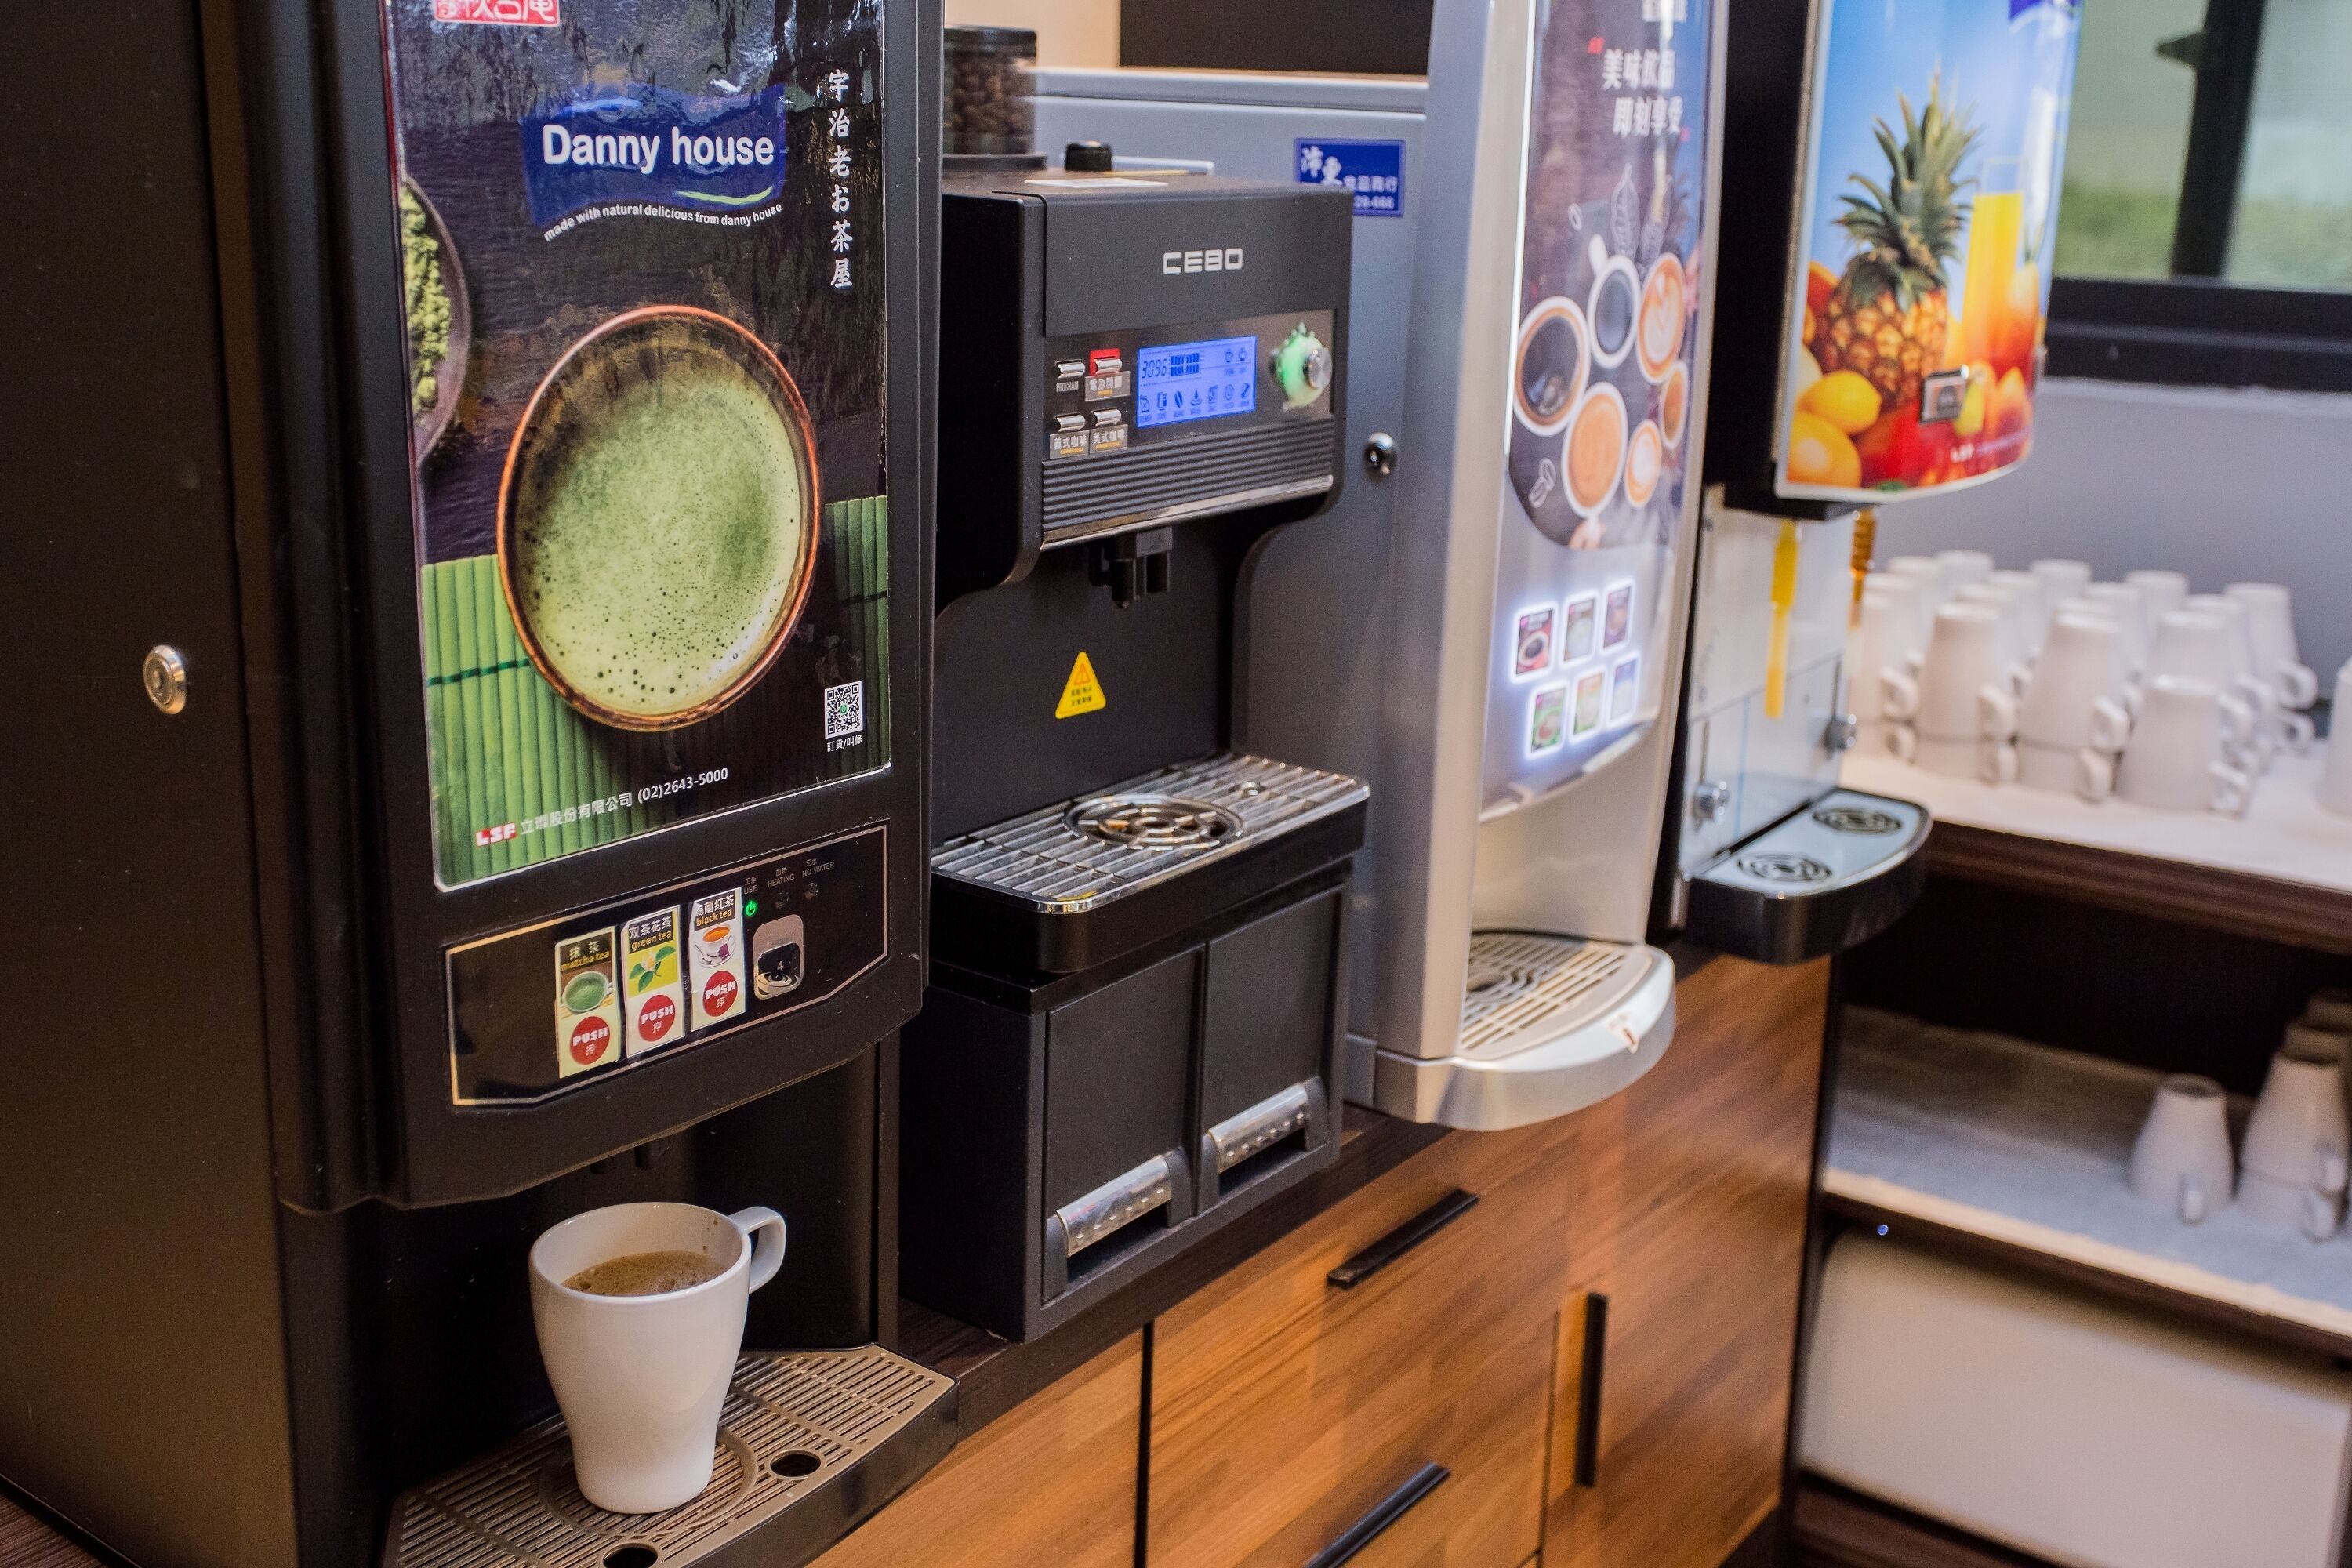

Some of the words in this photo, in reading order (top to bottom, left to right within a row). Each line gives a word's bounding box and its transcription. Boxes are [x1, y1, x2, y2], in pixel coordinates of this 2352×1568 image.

[543, 125, 660, 174] Danny
[672, 126, 774, 165] house
[828, 68, 853, 289] 宇治老お茶屋
[544, 218, 575, 241] made
[575, 207, 601, 224] with
[602, 204, 643, 217] natural
[644, 206, 694, 222] delicious
[695, 212, 720, 226] from
[720, 214, 753, 227] danny
[753, 203, 782, 223] house
[1163, 248, 1243, 274] CEBO
[1142, 359, 1167, 379] 3096
[826, 734, 862, 753] 訂貨/叫修
[476, 822, 516, 847] LSF
[637, 767, 728, 804] (02)2643-5000
[802, 868, 811, 877] NO
[813, 861, 835, 873] WATER
[768, 873, 795, 887] HEATING
[696, 912, 719, 926] black
[719, 909, 732, 919] tea
[629, 916, 672, 940] 双茶花茶
[631, 935, 657, 953] green
[658, 931, 672, 941] tea
[561, 954, 595, 972] matcha
[595, 951, 610, 961] tea
[705, 981, 737, 1000] PUSH
[641, 1004, 674, 1024] PUSH
[572, 1027, 608, 1047] PUSH
